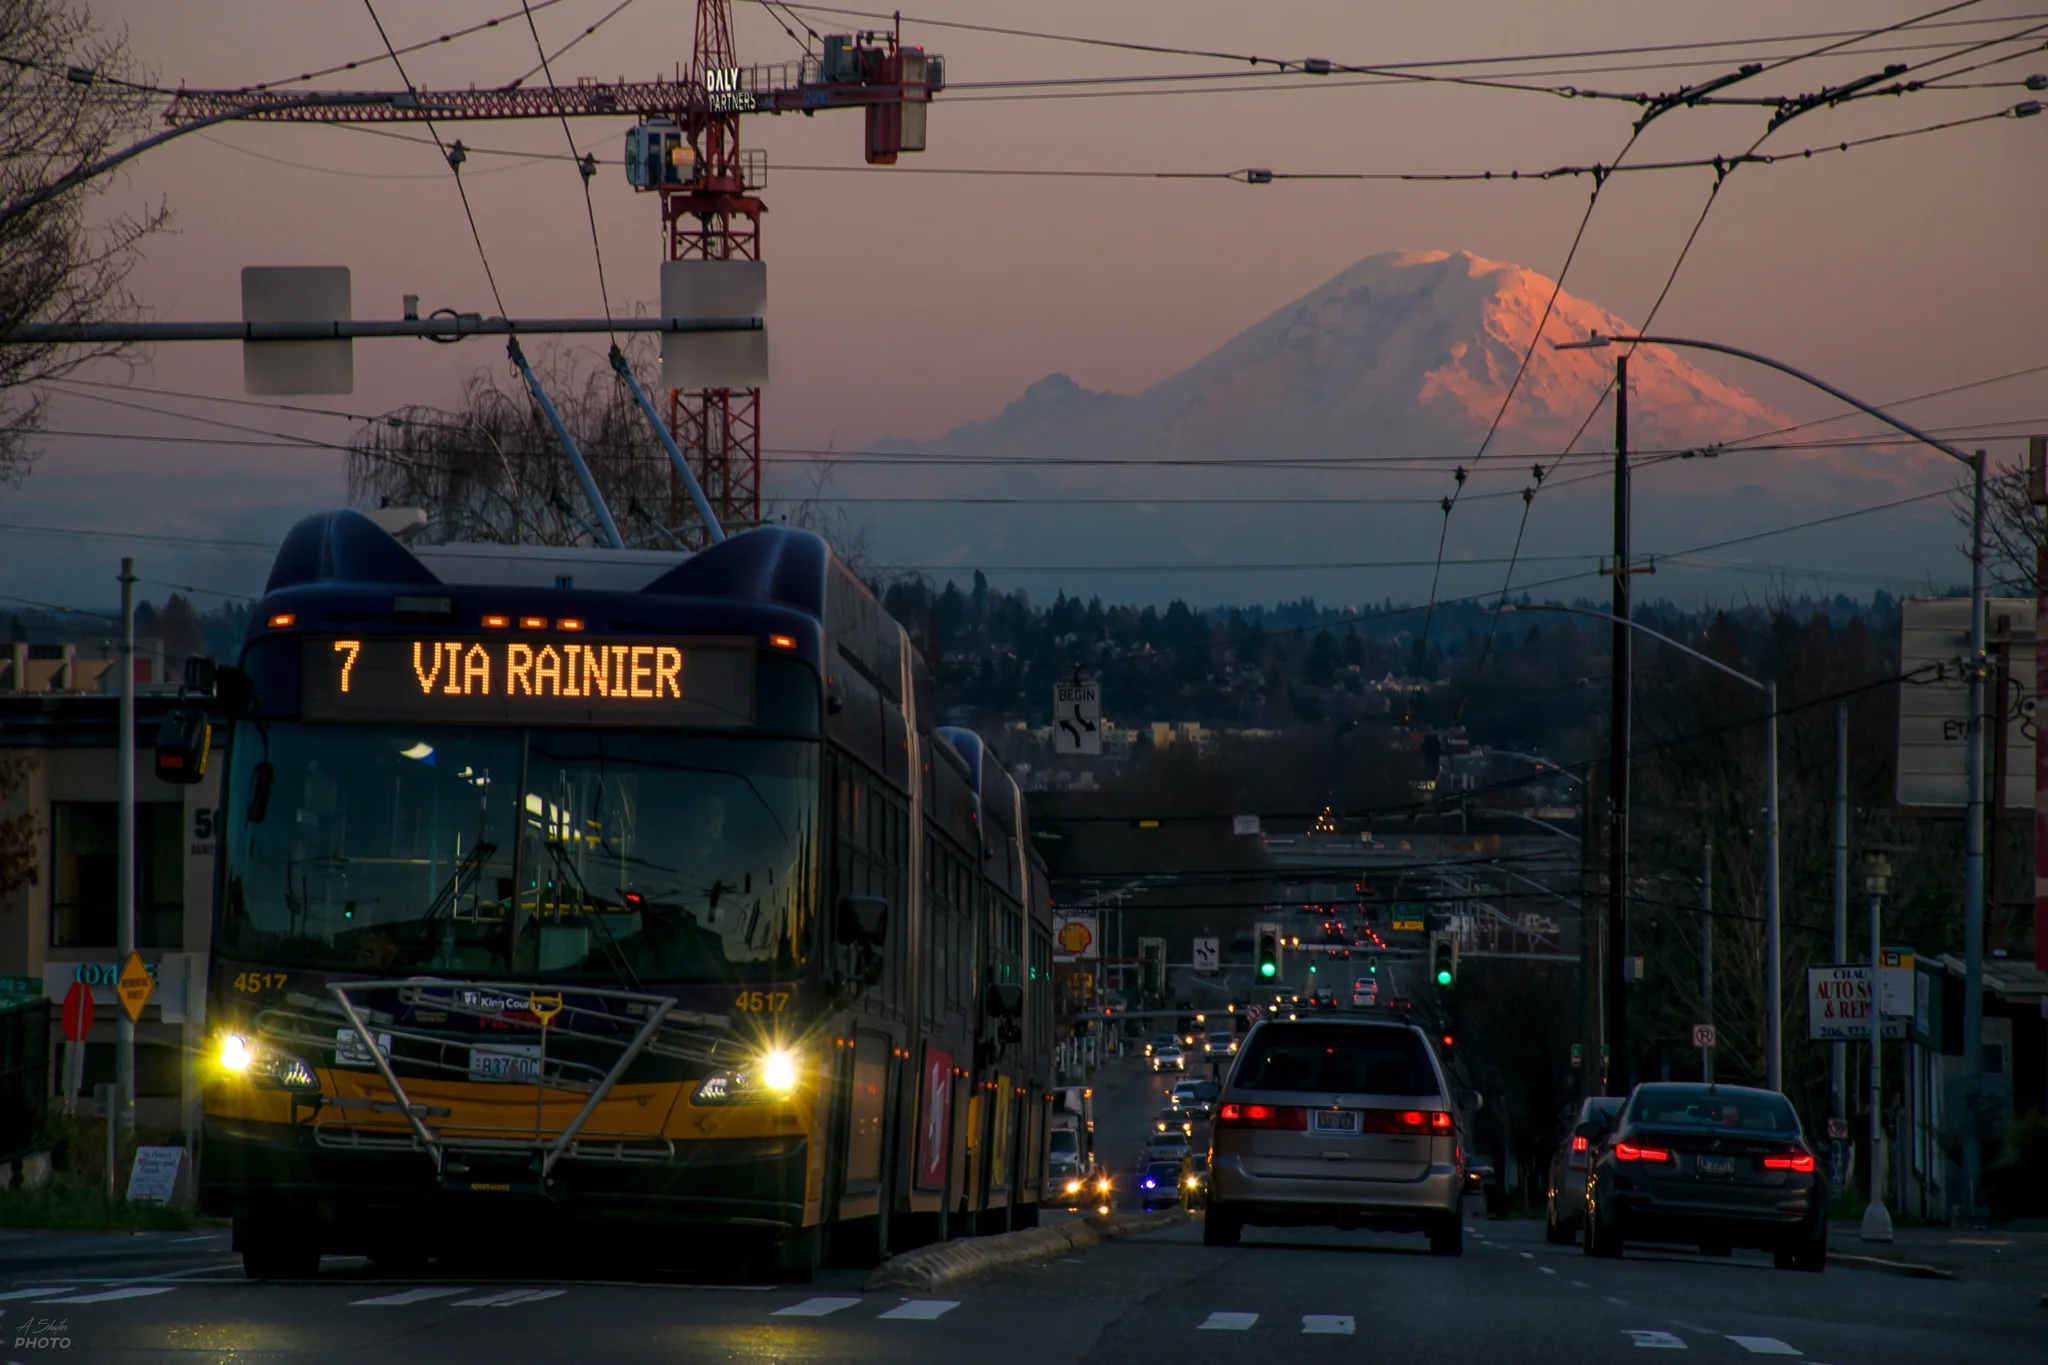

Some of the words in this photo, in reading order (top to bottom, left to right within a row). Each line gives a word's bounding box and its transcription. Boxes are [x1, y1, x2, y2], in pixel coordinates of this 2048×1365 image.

[707, 67, 738, 92] DALY
[709, 92, 756, 113] PARTNERS
[334, 640, 360, 692] 7
[413, 642, 490, 694] VIA
[507, 643, 682, 698] RAINIER
[1059, 688, 1095, 701] BEGIN
[233, 971, 288, 993] 4517
[1817, 981, 1854, 1000] AUTO
[481, 997, 505, 1009] King
[735, 991, 789, 1012] 4517
[1825, 1000, 1835, 1018] &
[1840, 1001, 1872, 1019] REP
